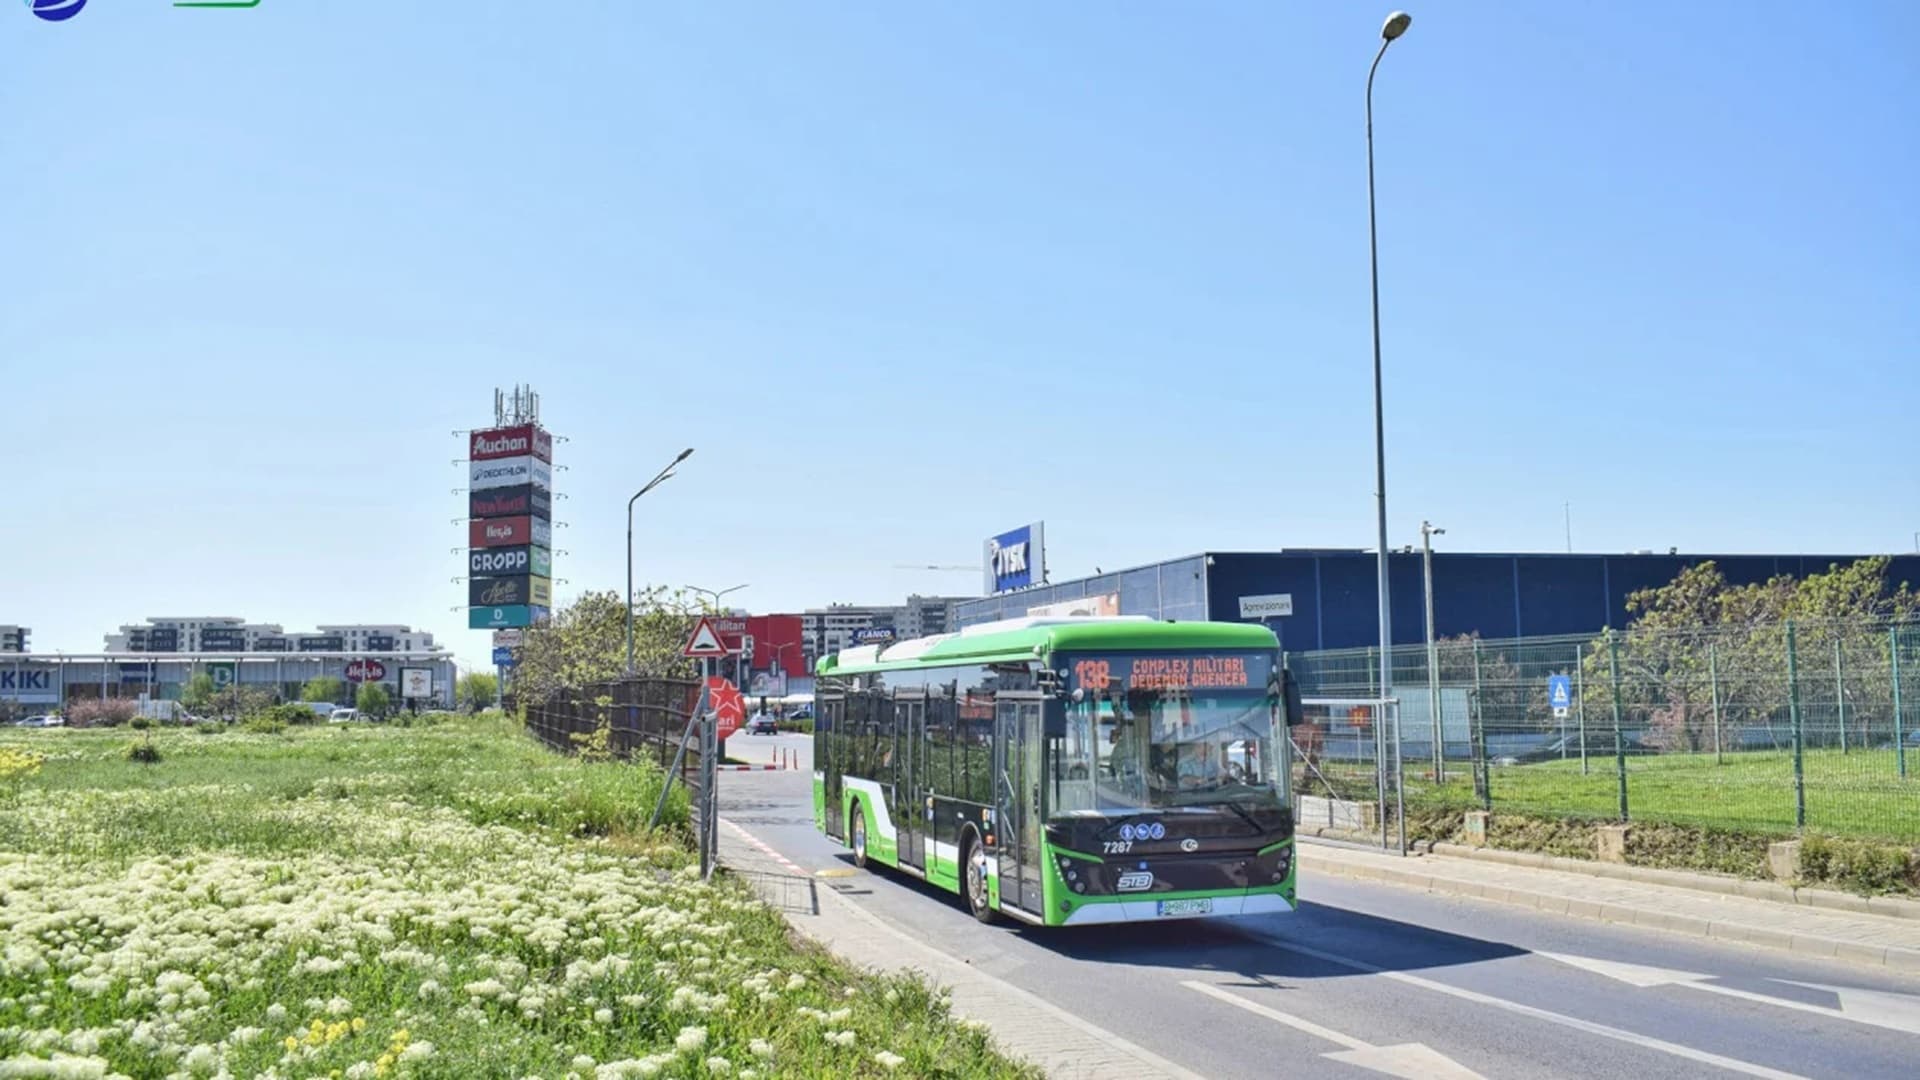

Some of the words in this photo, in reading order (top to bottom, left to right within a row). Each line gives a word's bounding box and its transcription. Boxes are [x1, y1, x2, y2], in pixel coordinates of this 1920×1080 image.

[473, 435, 527, 455] Auchan
[484, 465, 527, 478] DECATHLON
[471, 551, 527, 571] CROPP
[997, 541, 1026, 577] JYSK
[494, 608, 503, 620] D
[713, 618, 746, 632] ilitari
[857, 629, 891, 639] FLANCO
[346, 665, 384, 680] Hevis
[1132, 658, 1189, 674] COMPLEX
[1193, 657, 1244, 673] MILITARI
[1, 670, 50, 689] KIKI
[1074, 659, 1111, 689] 138
[1129, 673, 1188, 689] DEDEMAN
[1103, 840, 1133, 854] 7287
[1117, 875, 1151, 889] STB
